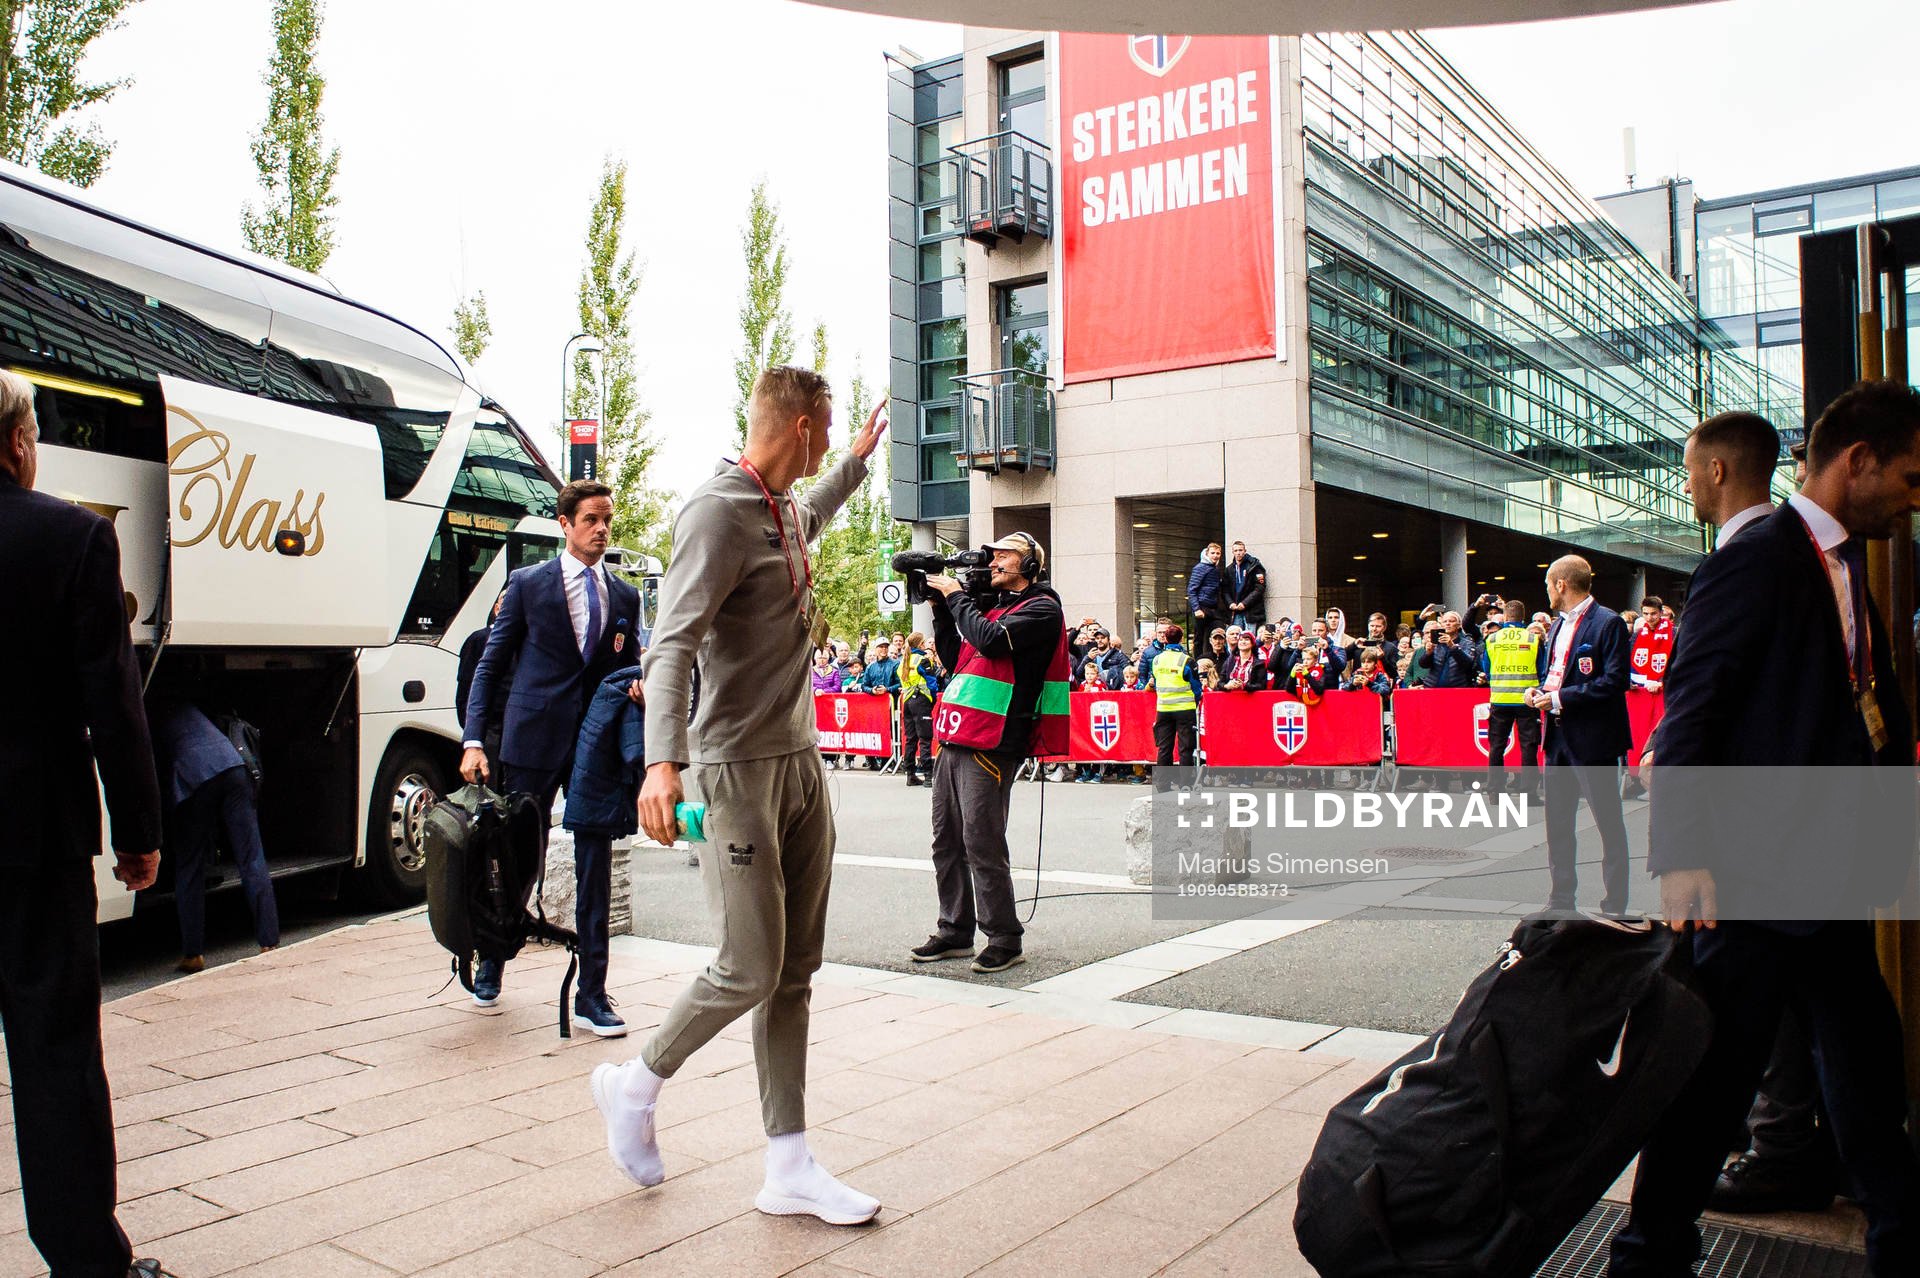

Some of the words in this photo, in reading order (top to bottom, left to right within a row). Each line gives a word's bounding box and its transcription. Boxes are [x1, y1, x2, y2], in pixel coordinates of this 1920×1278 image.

[1072, 70, 1258, 163] STERKERE
[1082, 142, 1249, 228] SAMMEN
[168, 403, 325, 557] Class
[1502, 629, 1522, 641] 505
[1493, 643, 1518, 652] PSS
[1496, 665, 1529, 673] VEKTER
[844, 731, 882, 751] SAMMEN
